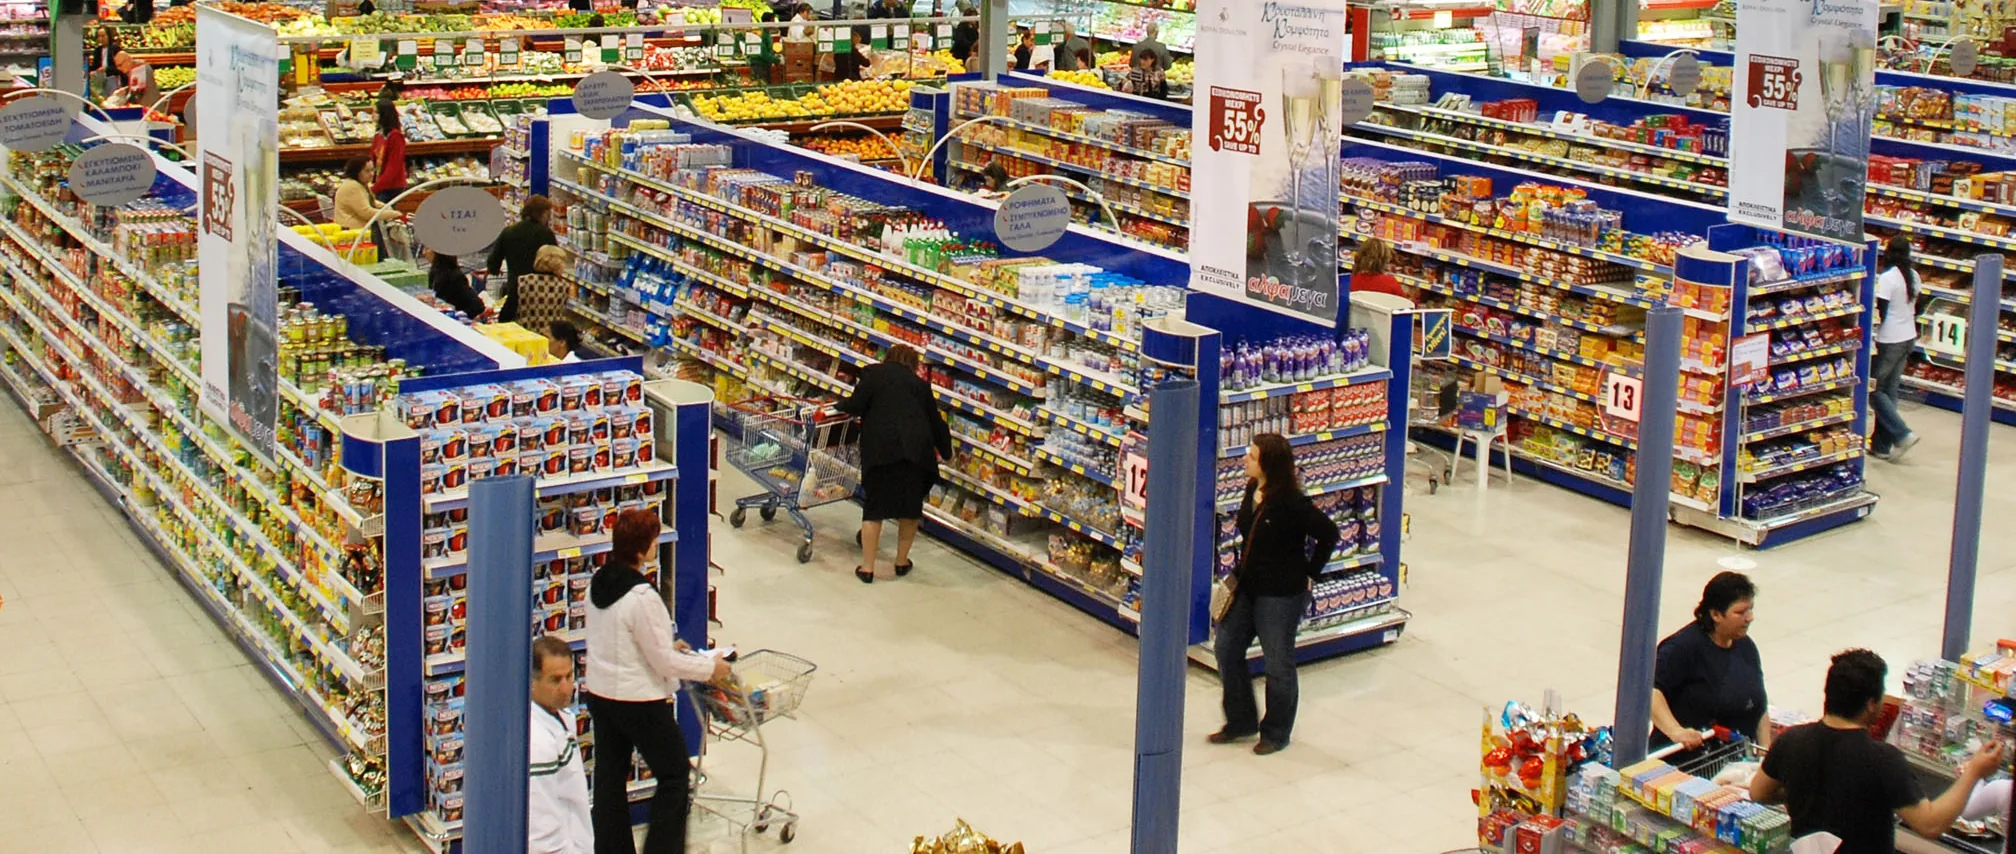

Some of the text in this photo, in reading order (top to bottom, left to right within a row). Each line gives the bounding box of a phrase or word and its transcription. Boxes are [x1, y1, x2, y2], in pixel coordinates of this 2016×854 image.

[1273, 40, 1329, 55] Crystal Elegance
[1763, 73, 1798, 102] 55%
[1224, 109, 1260, 144] 55%
[1009, 197, 1056, 209] ΡΟΦΗΜΑΤΑ
[1739, 210, 1777, 220] EXCLUSIVELY
[1009, 222, 1031, 231] ΓΑΛΑ
[1201, 275, 1240, 289] EXCLUSIVELY
[1938, 320, 1958, 345] 14
[1613, 381, 1635, 411] 13
[1131, 464, 1148, 498] 12
